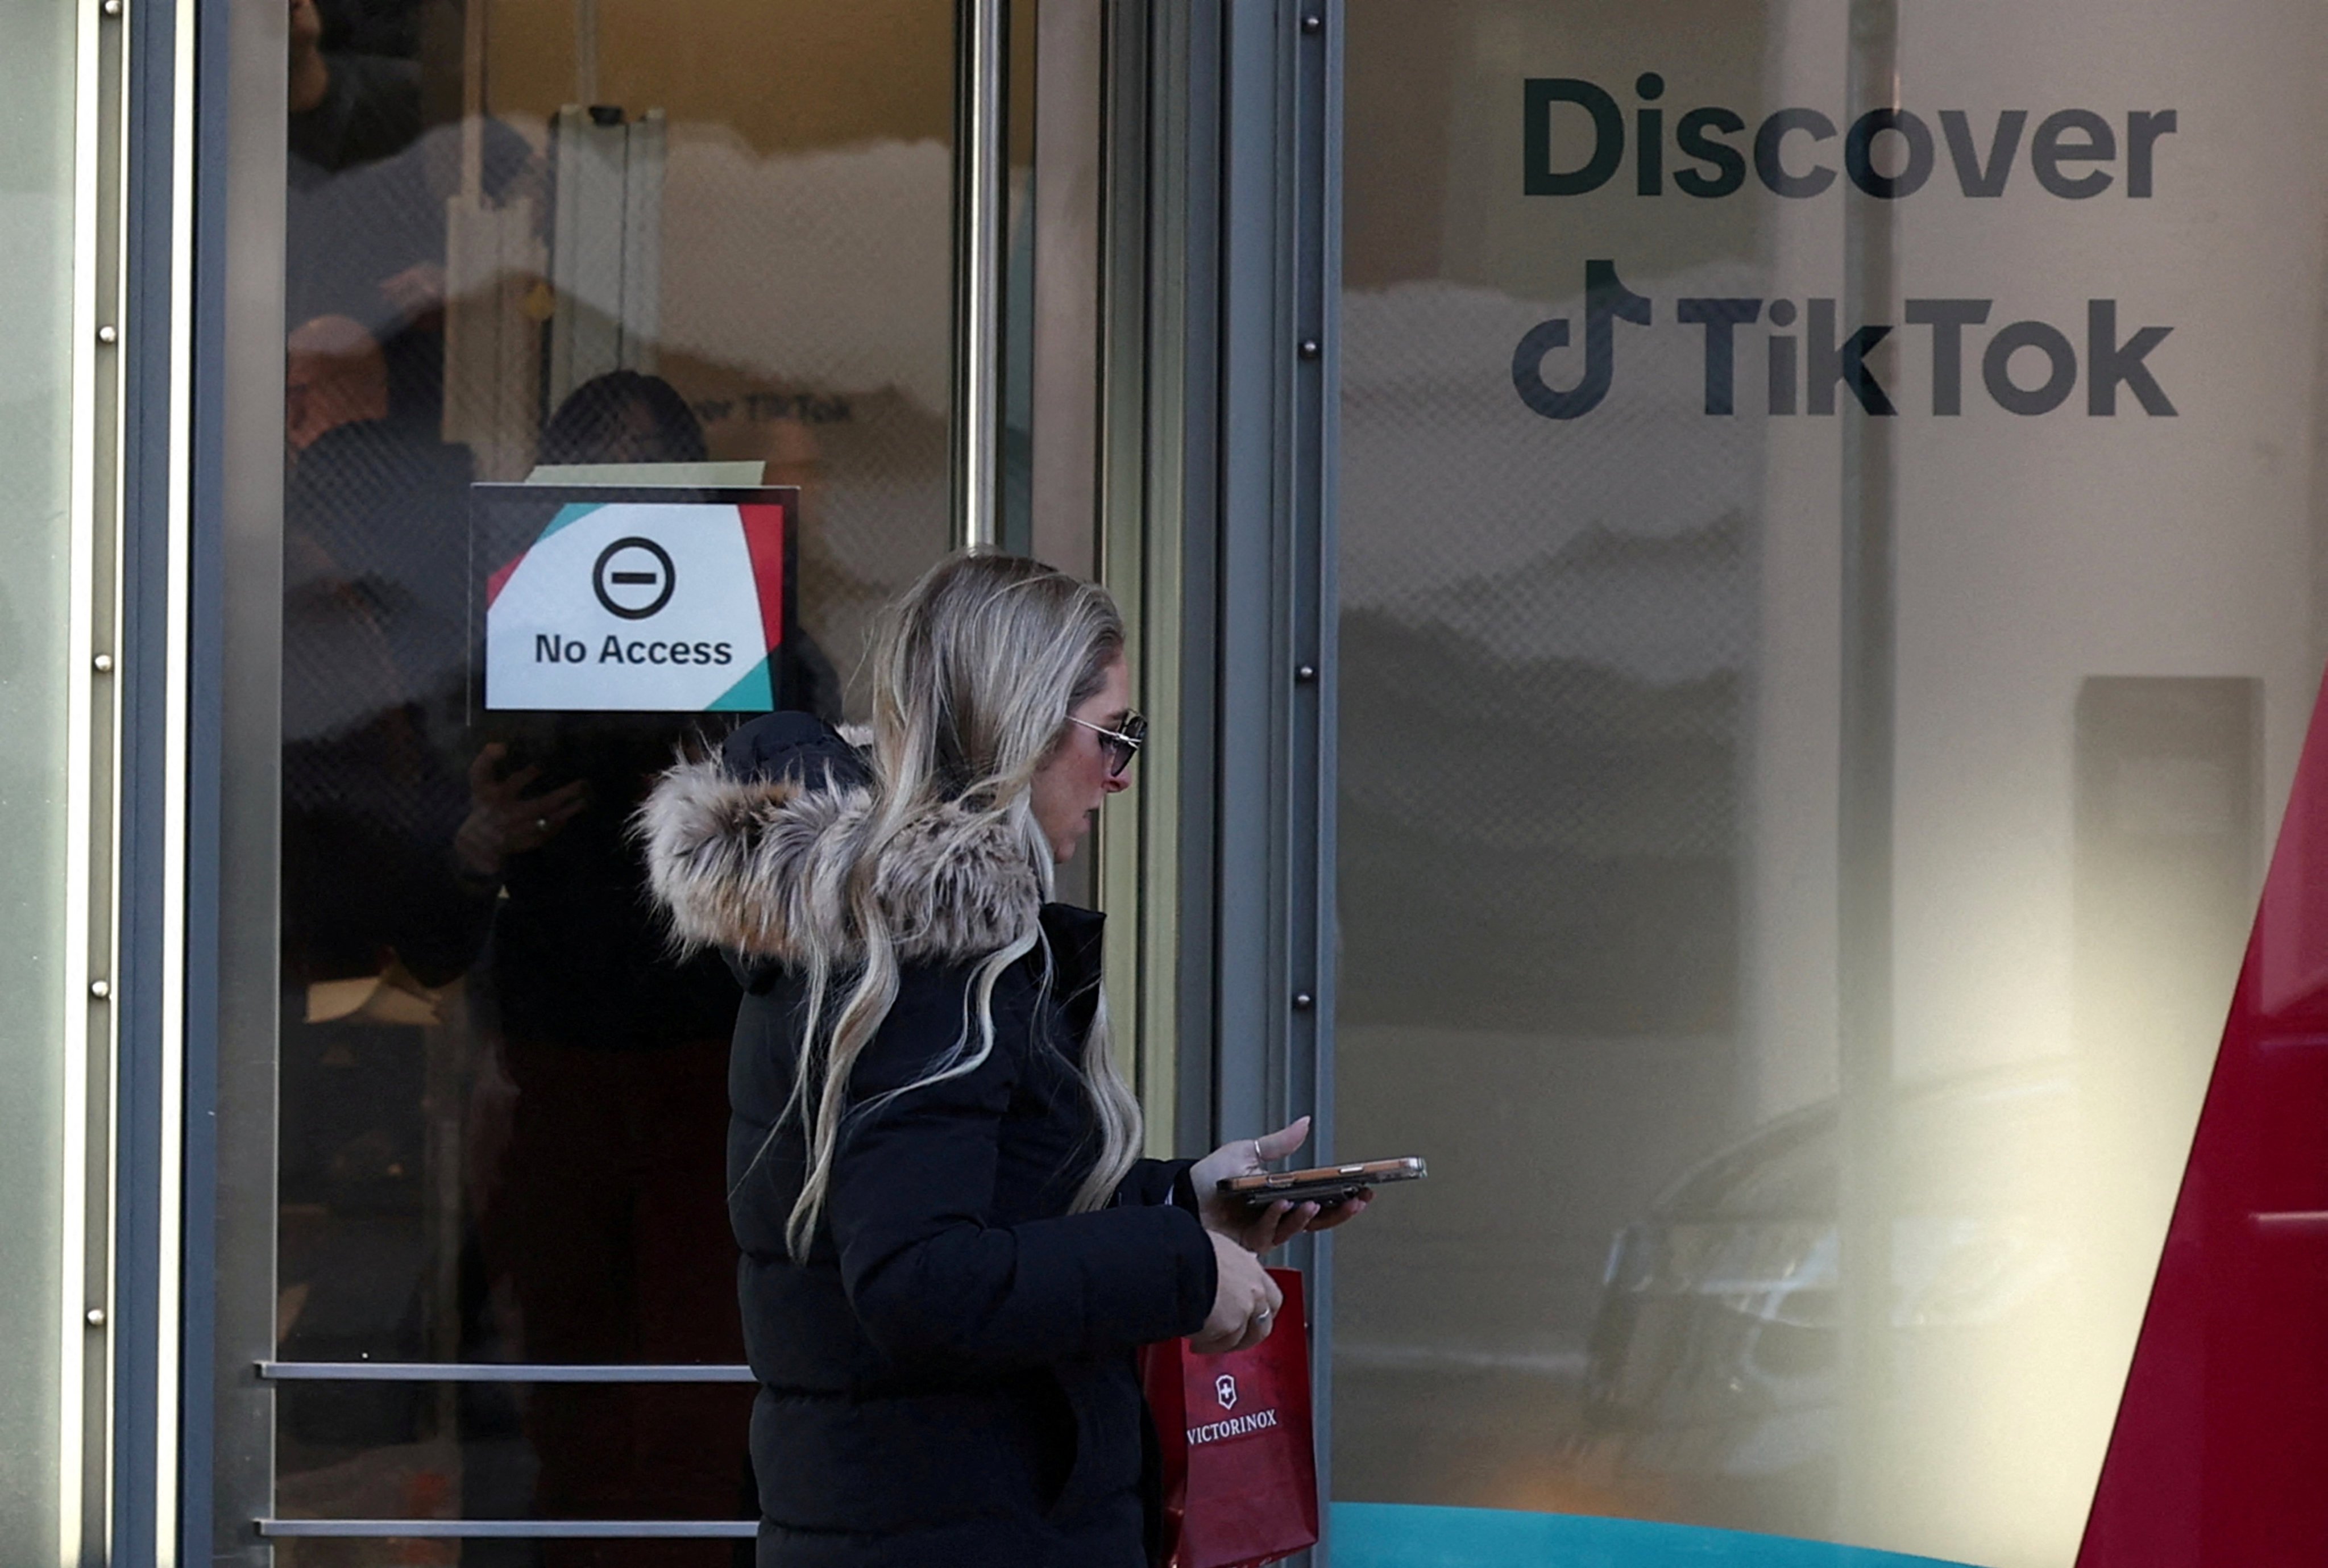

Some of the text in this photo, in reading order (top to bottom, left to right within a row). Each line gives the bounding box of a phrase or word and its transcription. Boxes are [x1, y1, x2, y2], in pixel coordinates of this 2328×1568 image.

[1524, 72, 2177, 199] Discover
[1677, 298, 2179, 415] TikTok
[536, 634, 732, 665] No Access
[1186, 1409, 1277, 1445] VICTORINOX
